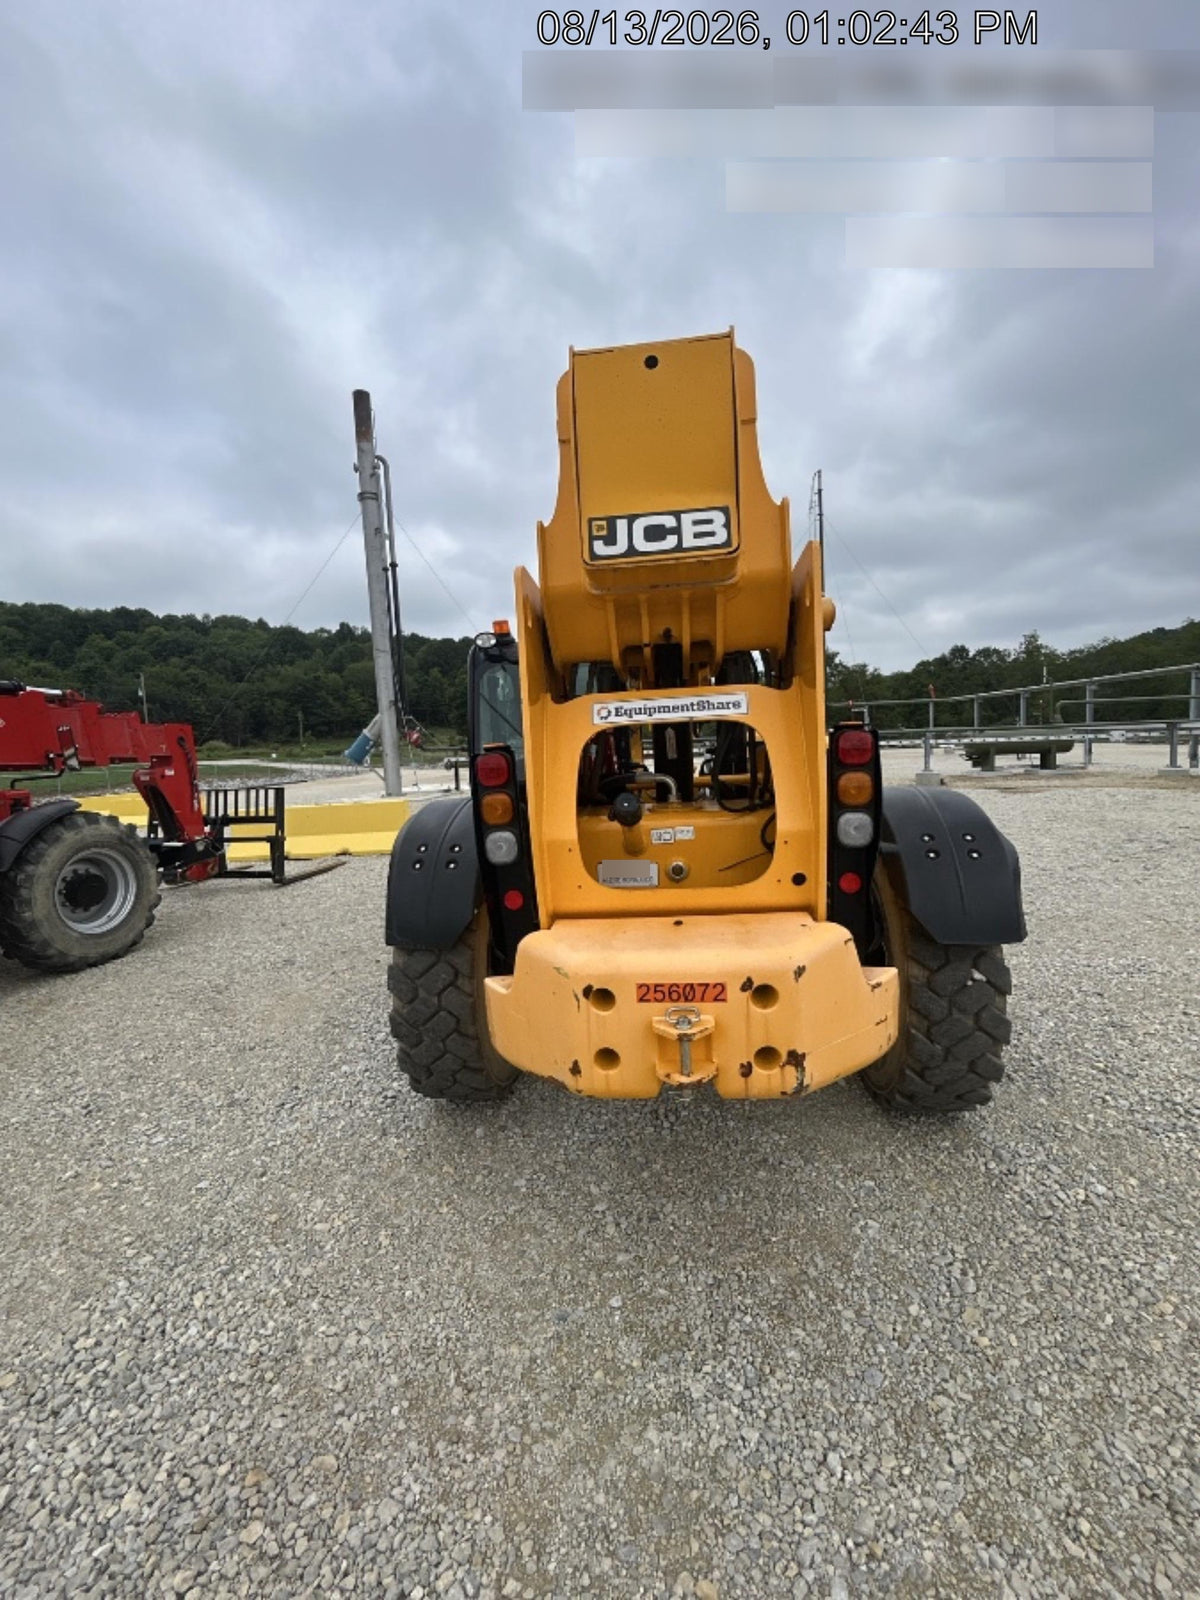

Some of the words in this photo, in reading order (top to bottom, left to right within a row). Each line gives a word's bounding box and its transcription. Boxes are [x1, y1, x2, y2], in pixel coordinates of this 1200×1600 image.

[592, 509, 728, 557] JCB
[613, 699, 743, 719] EquipmentShare
[637, 982, 727, 1003] 256072
